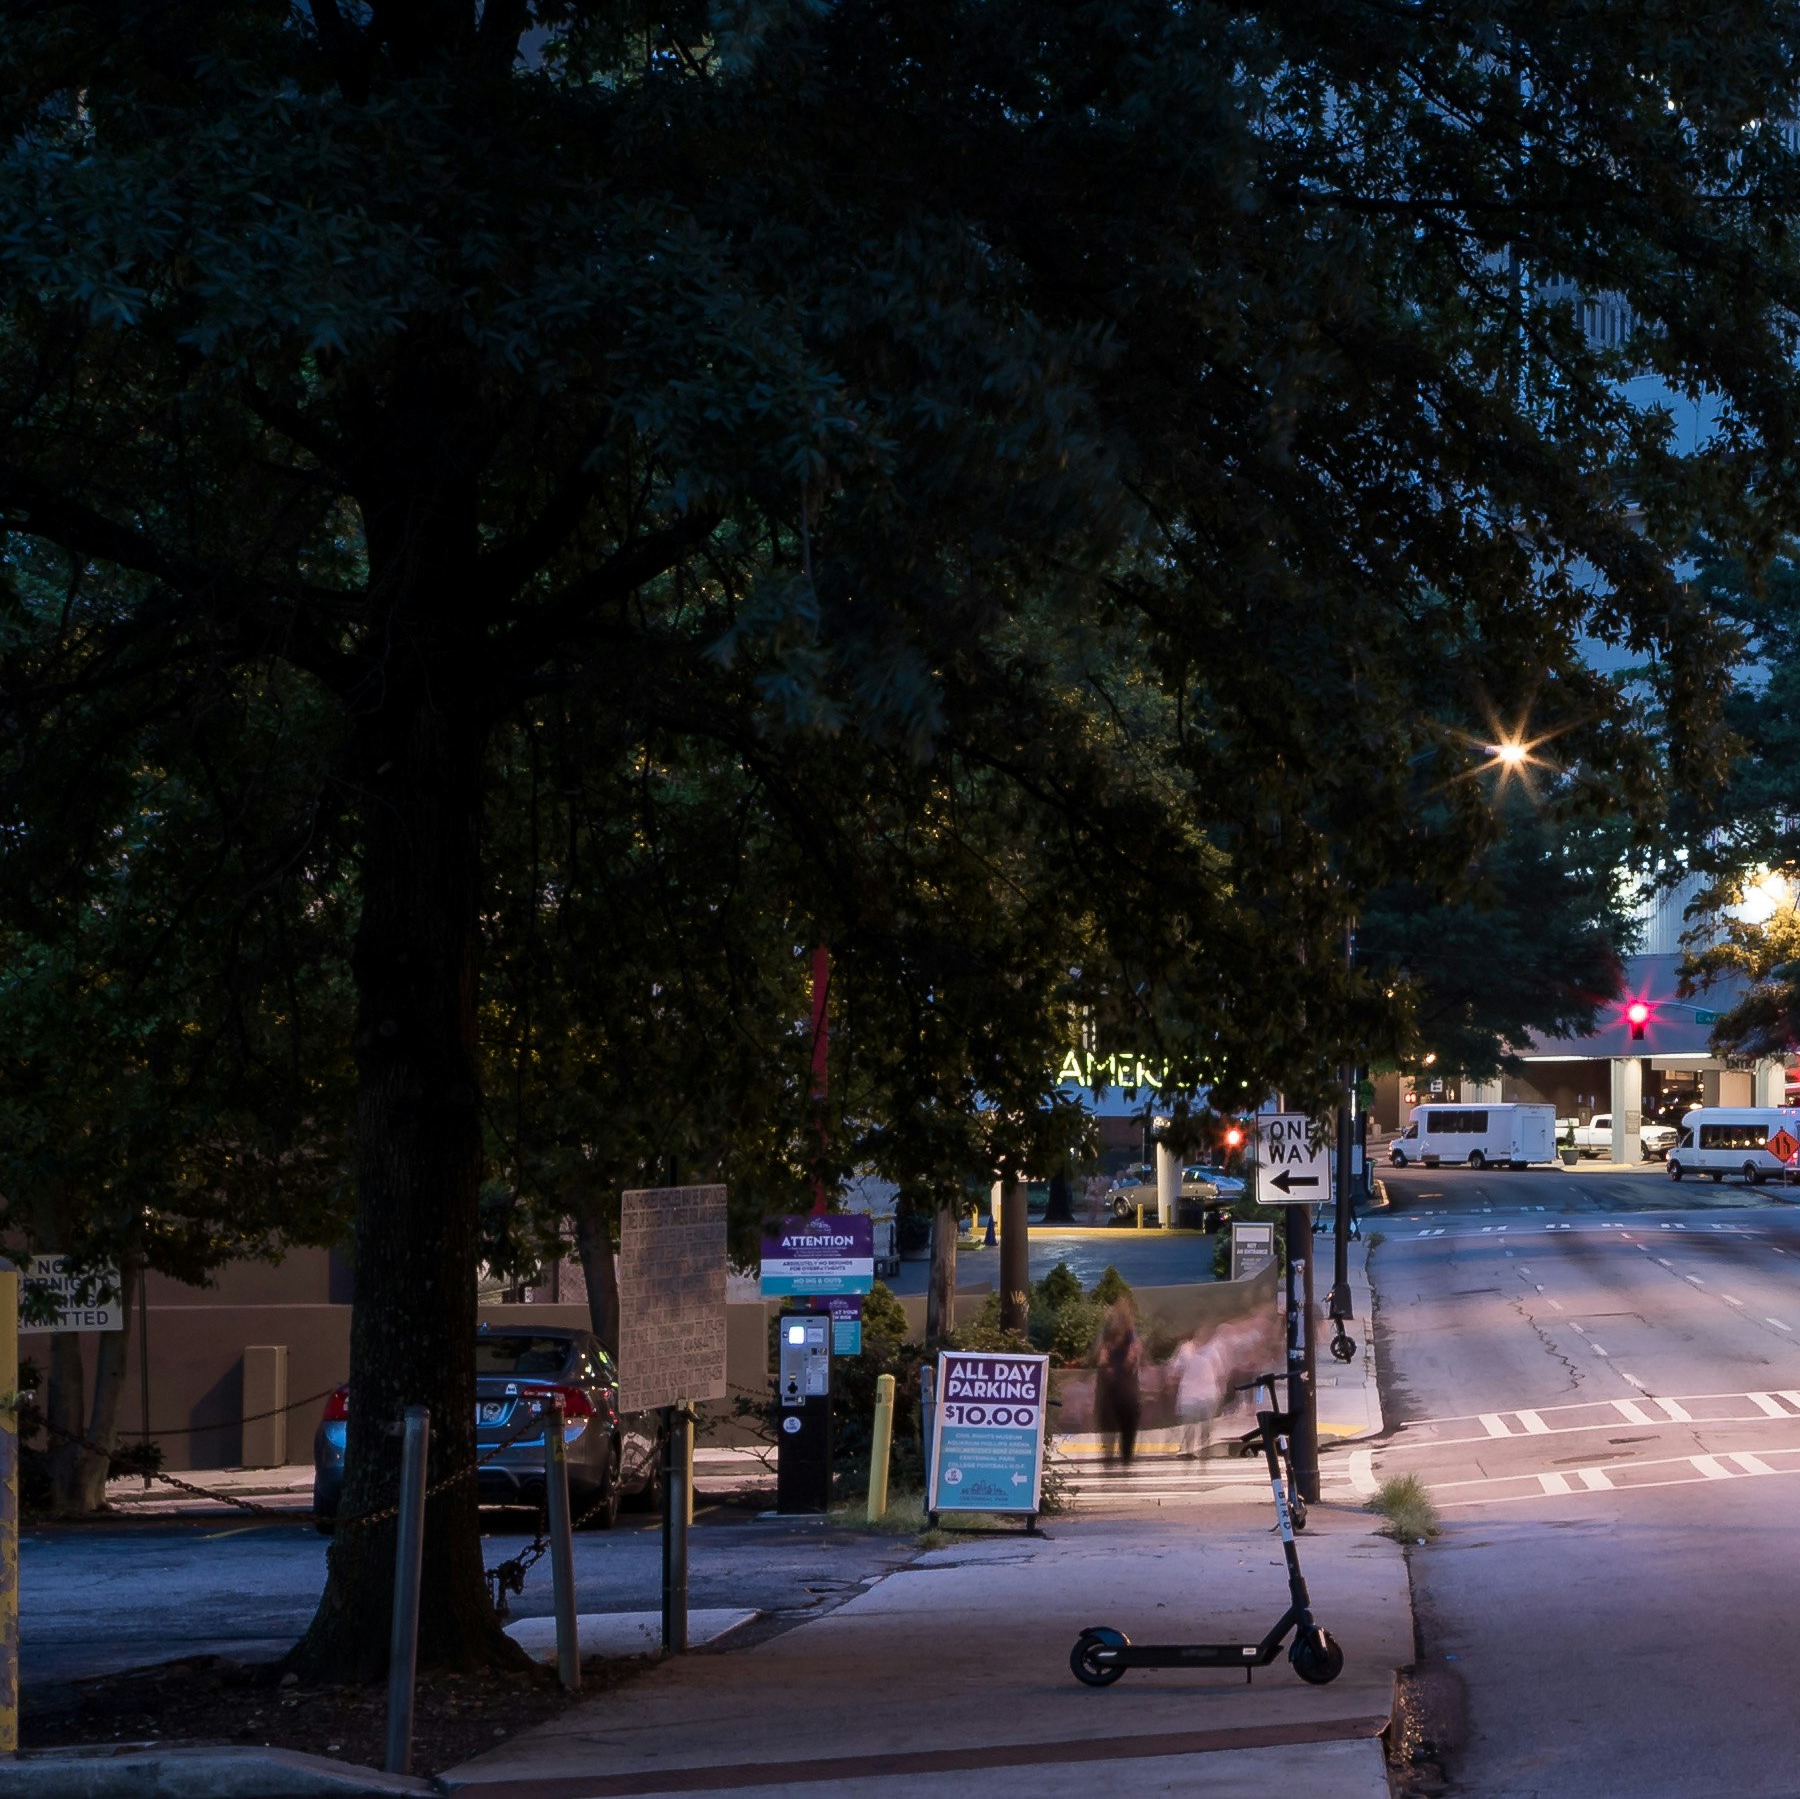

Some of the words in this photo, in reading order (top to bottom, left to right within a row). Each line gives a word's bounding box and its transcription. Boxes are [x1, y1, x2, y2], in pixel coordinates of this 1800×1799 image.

[1270, 1120, 1316, 1141] ONE
[1269, 1143, 1318, 1164] WAY
[781, 1235, 854, 1247] ATTENTION
[950, 1361, 989, 1380] ALL
[994, 1363, 1036, 1382] DAY
[948, 1380, 1036, 1399] PARKING
[945, 1405, 1034, 1427] $10.00
[1278, 1491, 1292, 1530] BIRD
